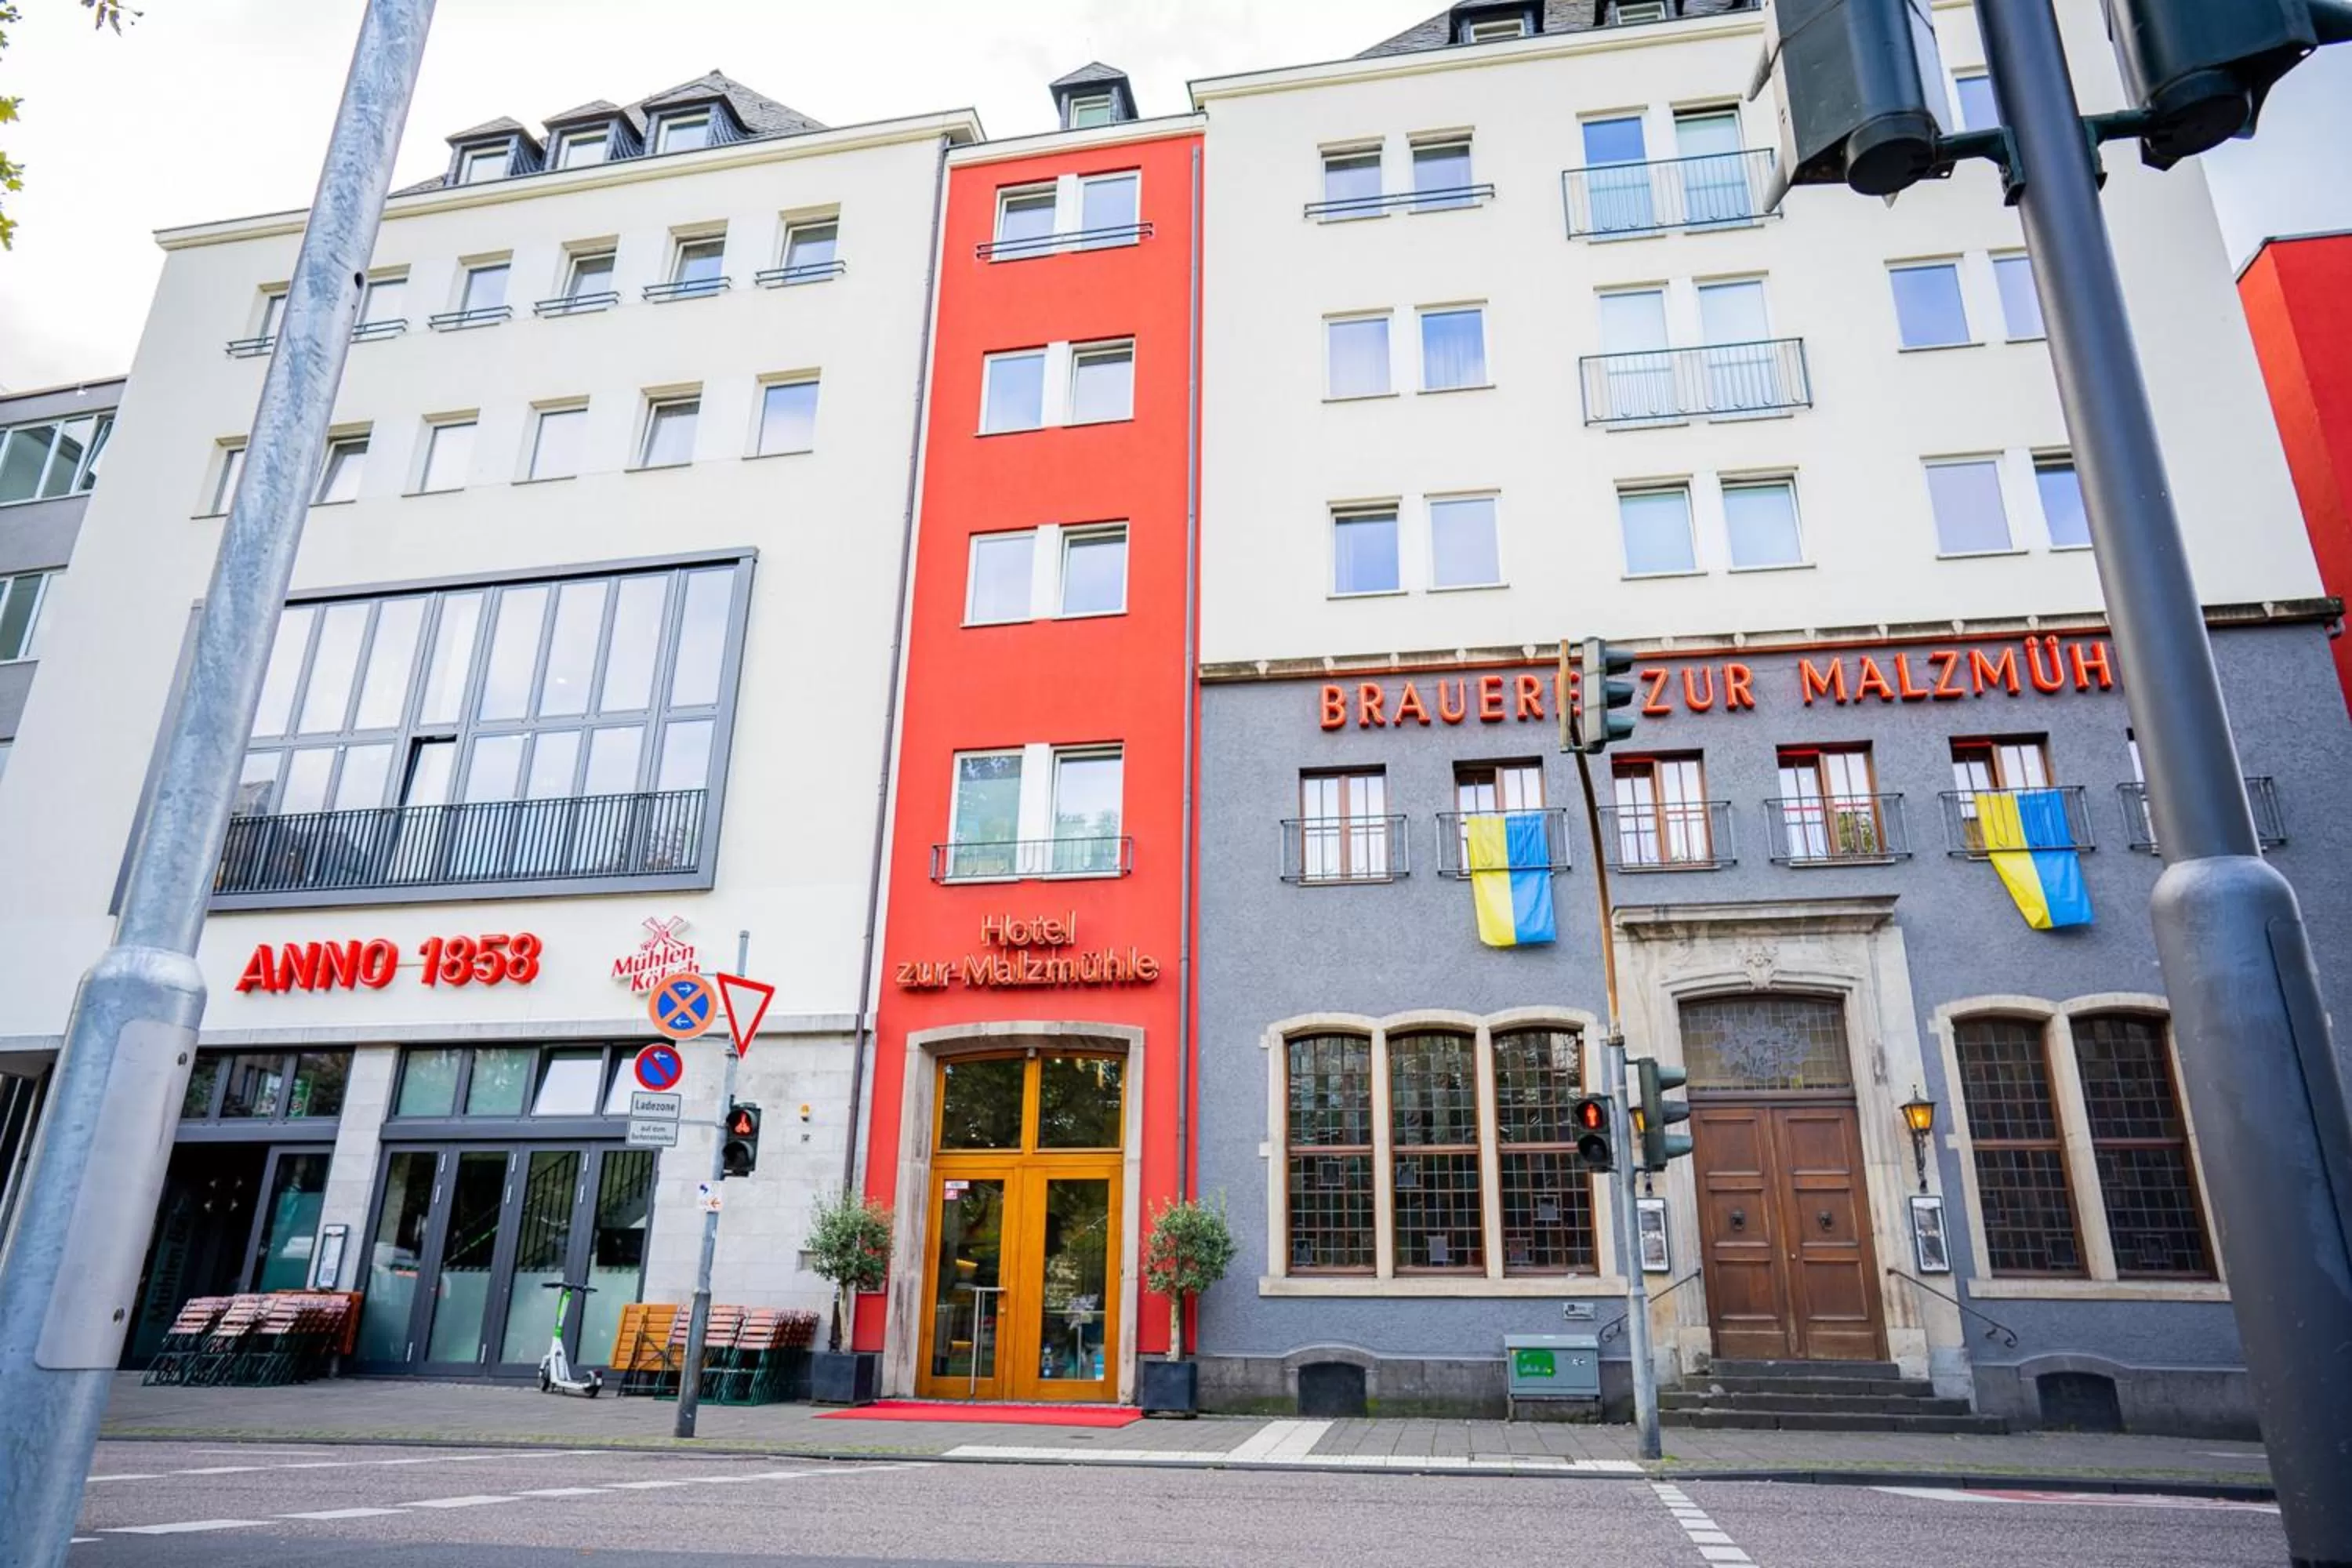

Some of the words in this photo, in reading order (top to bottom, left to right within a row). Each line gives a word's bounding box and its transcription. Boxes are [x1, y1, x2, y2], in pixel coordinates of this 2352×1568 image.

[1319, 672, 1583, 731] BRAUERE
[1639, 663, 1755, 715] ZUR
[1798, 635, 2113, 705] MALZMÜH
[981, 910, 1076, 946] Hotel
[234, 938, 399, 993] ANNO
[419, 932, 543, 988] 1858
[612, 946, 695, 978] Mühlen
[896, 960, 955, 988] zur
[961, 946, 1161, 986] Malzmühle
[635, 1099, 676, 1112] Ladezone
